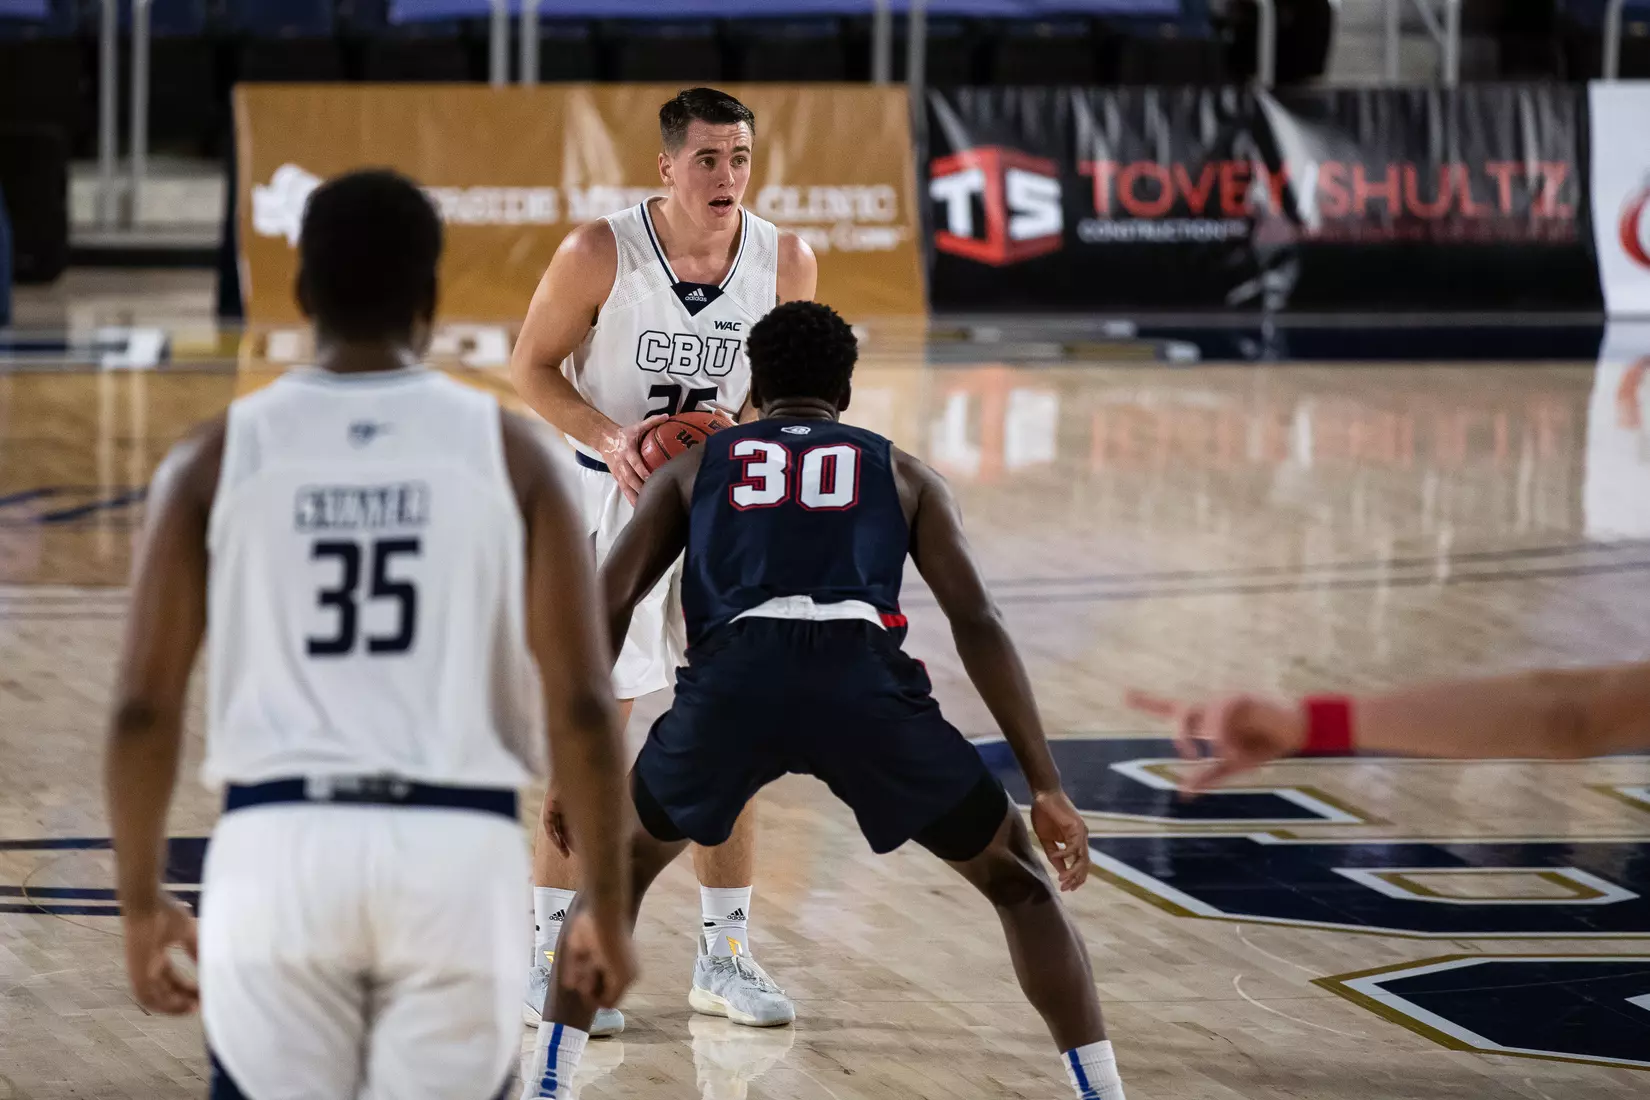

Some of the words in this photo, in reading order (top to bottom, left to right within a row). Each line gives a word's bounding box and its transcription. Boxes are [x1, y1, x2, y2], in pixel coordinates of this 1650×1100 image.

[1318, 160, 1574, 218] SHULTZ
[684, 295, 708, 303] adidas
[713, 320, 742, 332] WAC
[636, 330, 741, 377] CBU
[729, 438, 861, 511] 30
[305, 536, 422, 656] 35
